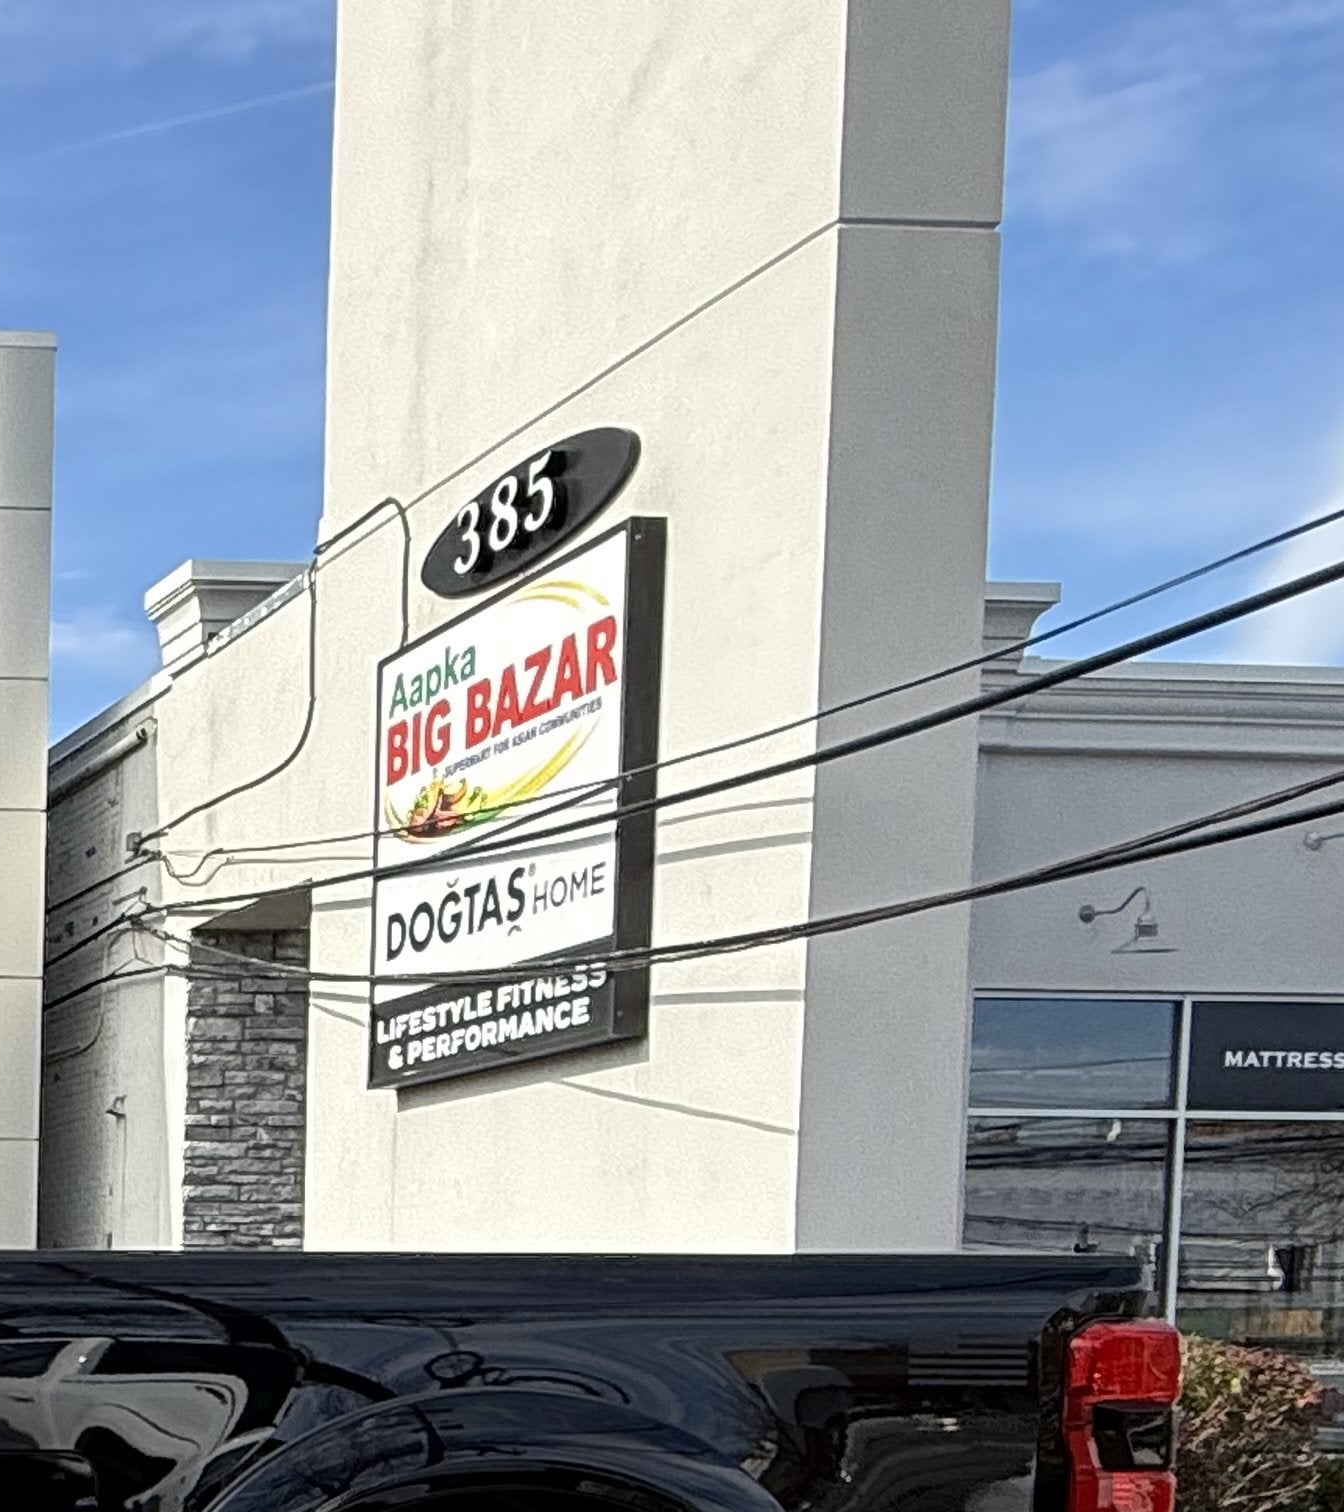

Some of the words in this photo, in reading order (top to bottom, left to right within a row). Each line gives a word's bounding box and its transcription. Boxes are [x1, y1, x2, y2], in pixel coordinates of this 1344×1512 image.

[453, 450, 554, 575] 385
[387, 698, 452, 786] BIG
[465, 615, 618, 750] BAZAR
[389, 645, 476, 718] Aapka
[532, 861, 607, 915] HOME
[376, 990, 493, 1045] LIFESTYLE
[496, 962, 607, 1012] FITNESS
[387, 1045, 404, 1070] &
[406, 996, 591, 1066] PERFORMANCE
[1224, 1050, 1344, 1069] MATTRESS
